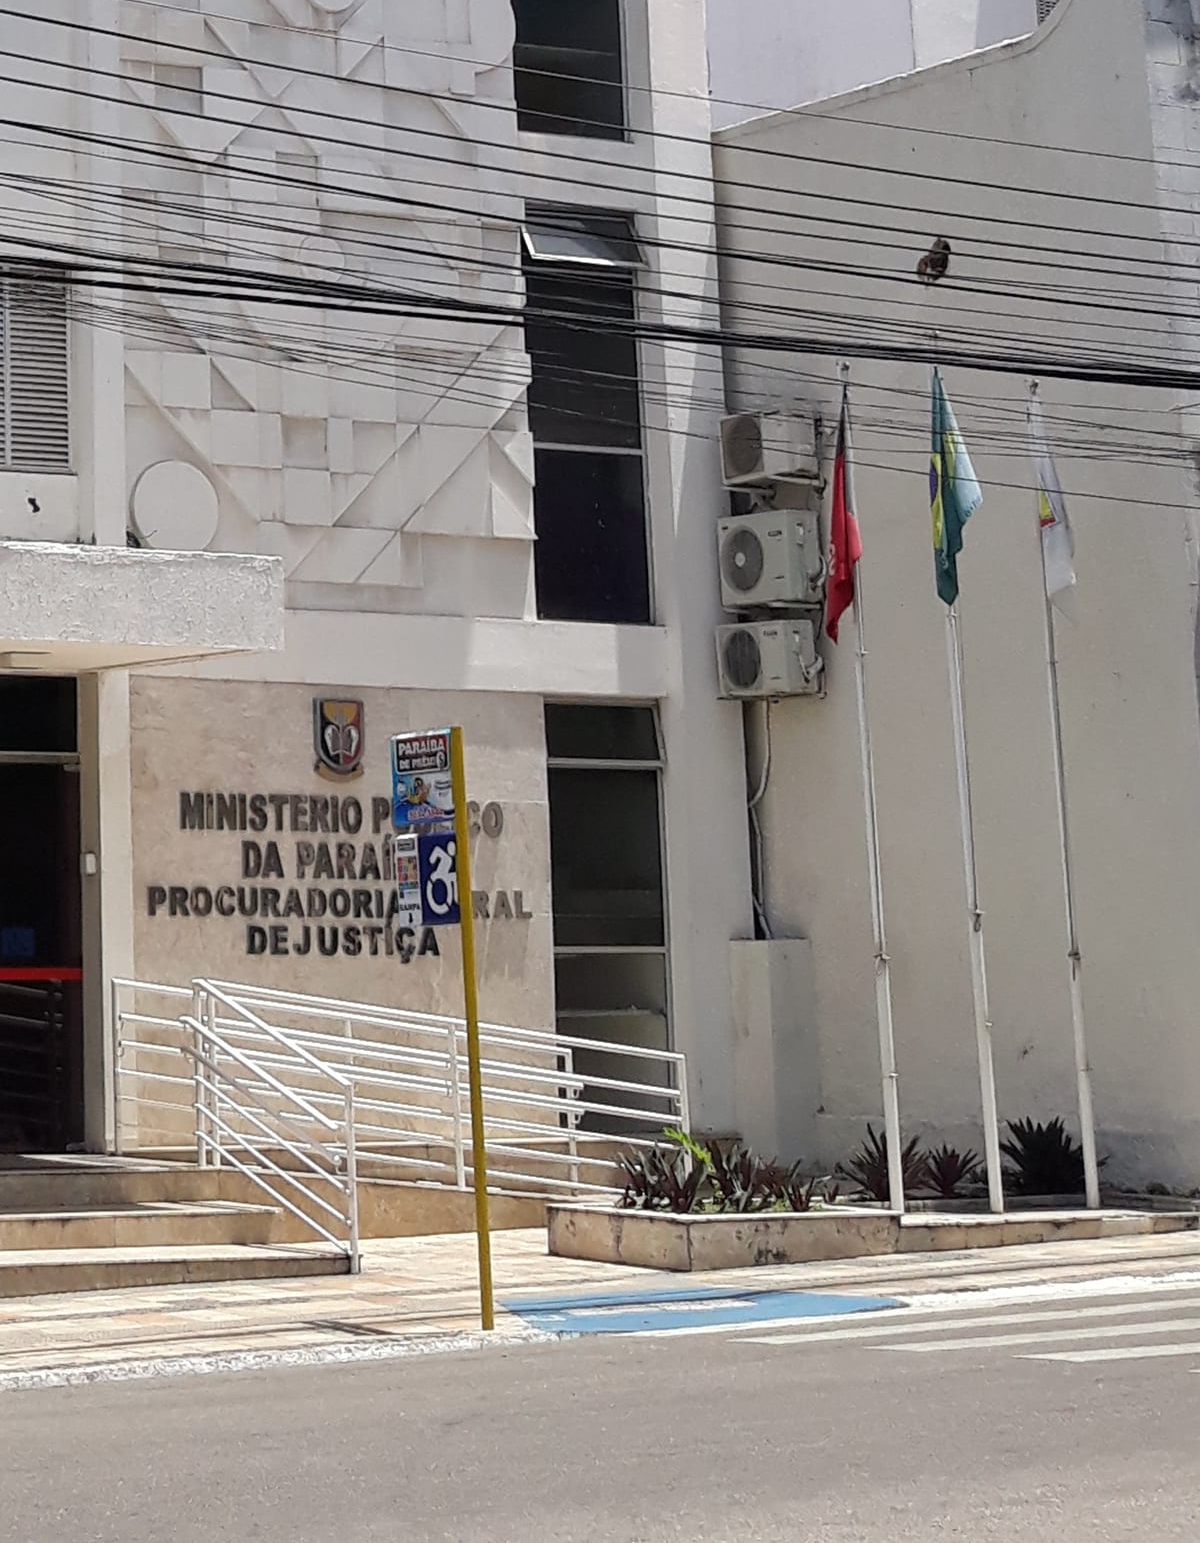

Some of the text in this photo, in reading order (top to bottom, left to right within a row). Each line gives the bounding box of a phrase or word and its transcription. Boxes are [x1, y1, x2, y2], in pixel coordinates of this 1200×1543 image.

[398, 737, 445, 756] PARAÍBA
[180, 791, 363, 835] MINISTERIO
[241, 833, 397, 881] DA PARAÍ
[471, 888, 533, 919] RAL
